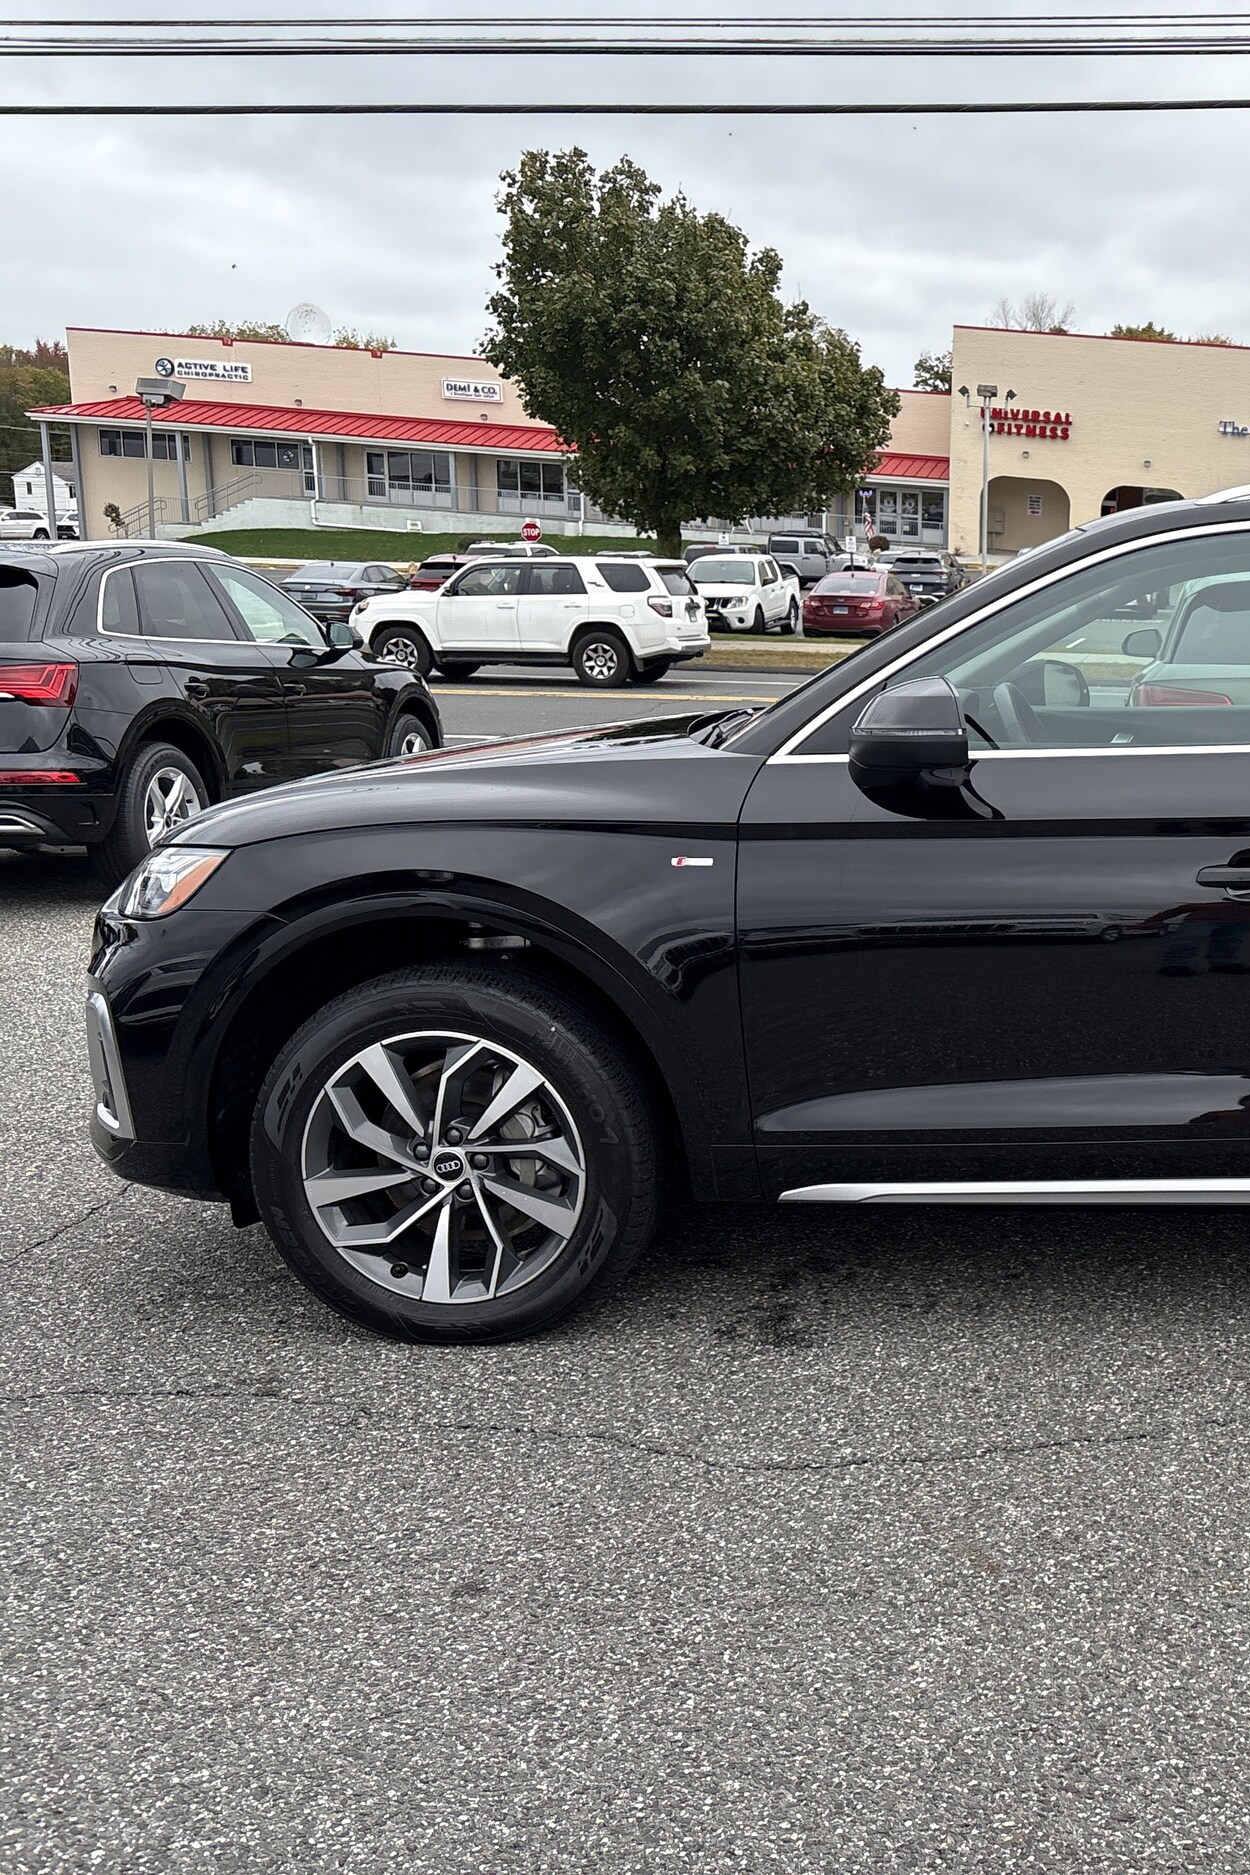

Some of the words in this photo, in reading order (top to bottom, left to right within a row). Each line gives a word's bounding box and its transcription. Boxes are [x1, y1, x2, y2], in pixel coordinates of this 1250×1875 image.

[177, 362, 217, 371] ACTIVE
[223, 365, 249, 373] LIFE
[177, 370, 249, 380] CHIROPRACTIC
[997, 423, 1069, 440] FITNESS
[1219, 420, 1248, 436] The
[523, 528, 539, 536] STOP
